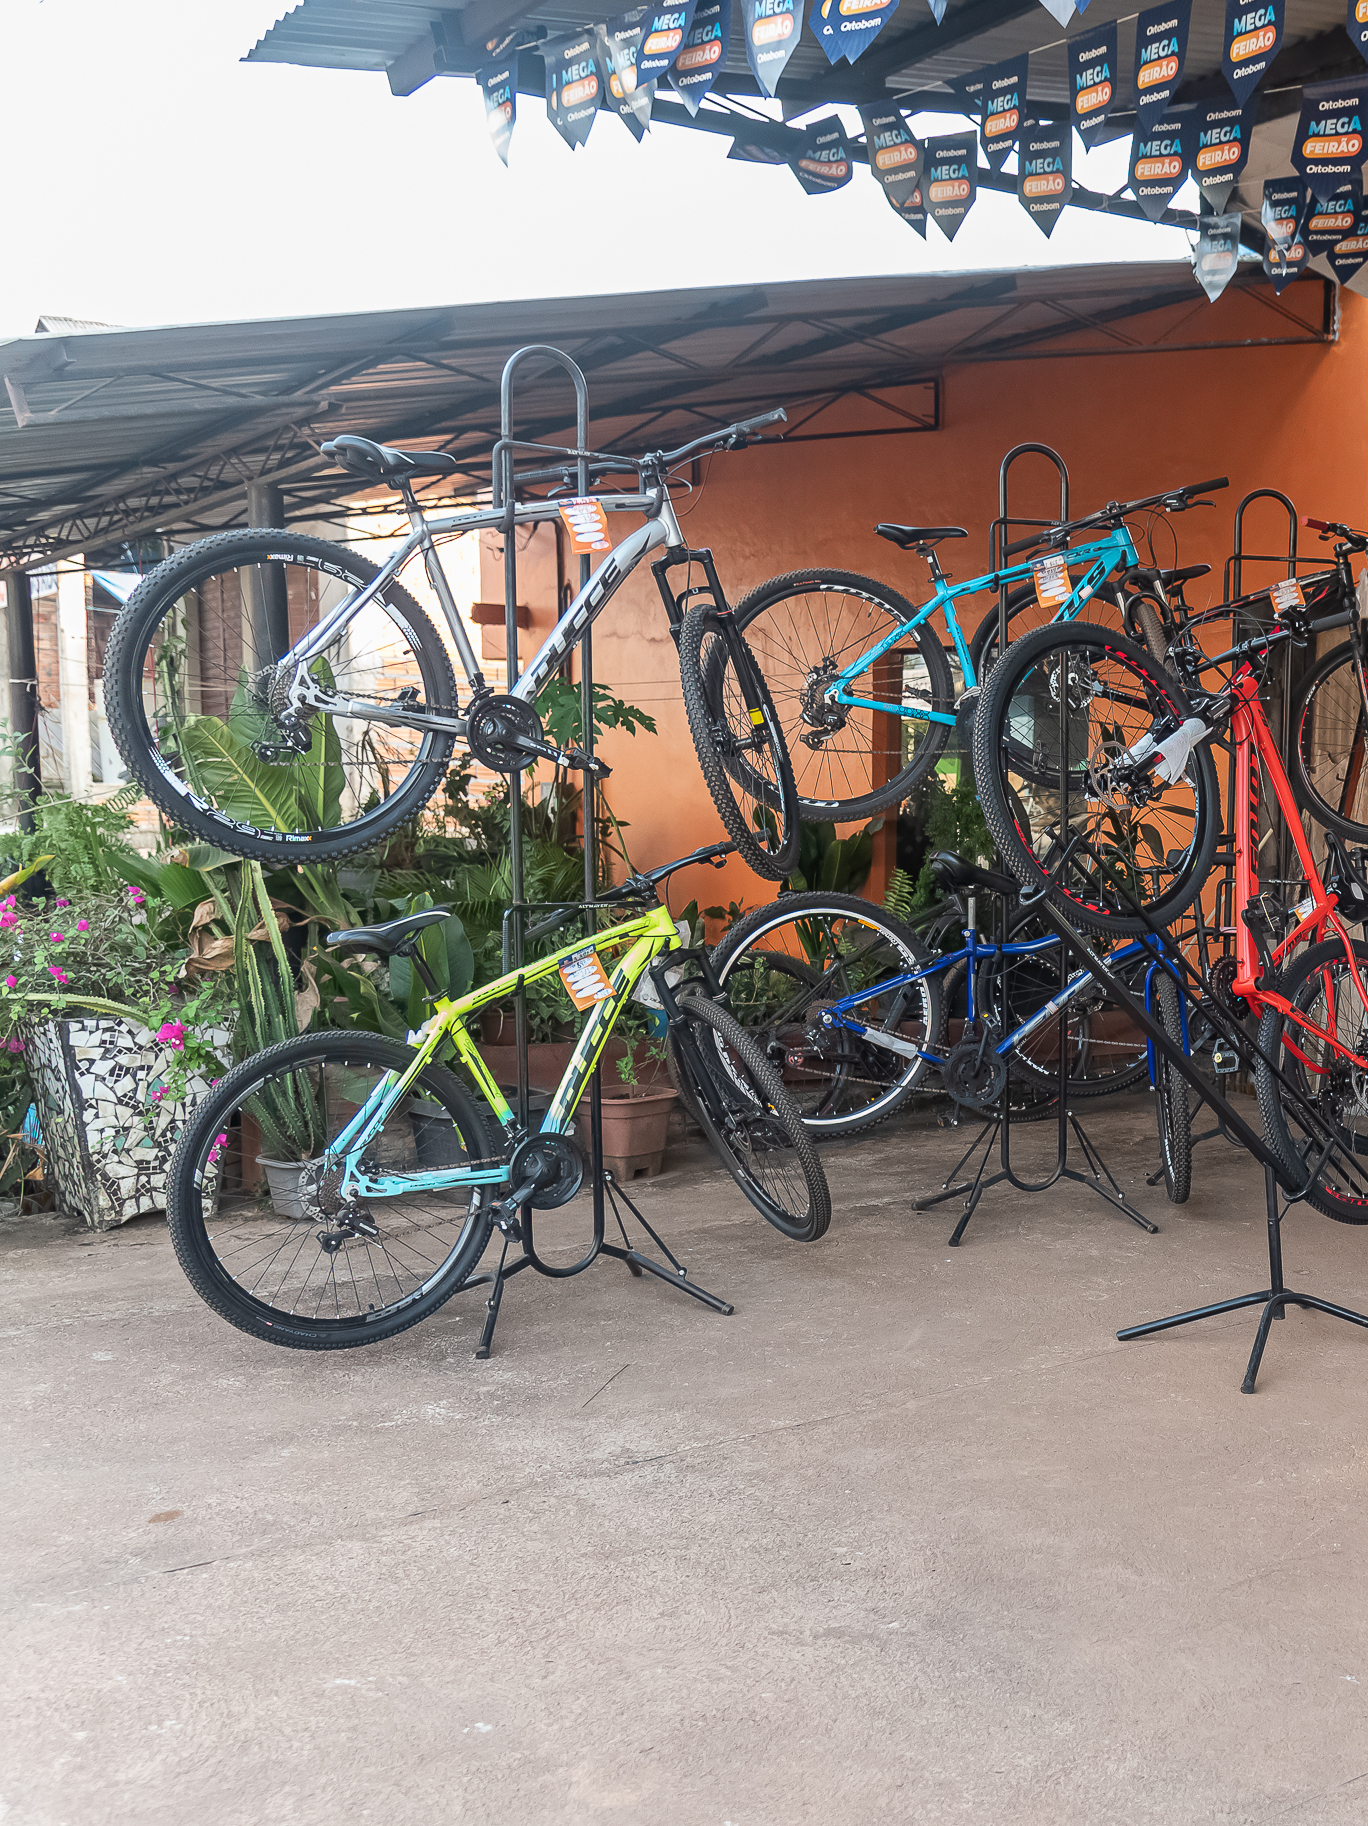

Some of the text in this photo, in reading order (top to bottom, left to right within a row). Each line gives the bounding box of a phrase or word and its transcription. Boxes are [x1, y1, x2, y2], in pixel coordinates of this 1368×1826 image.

[754, 0, 794, 18] MEGA
[651, 11, 686, 31] MEGA
[840, 17, 882, 32] Ortobom
[1146, 18, 1178, 36] Ortobom
[1233, 6, 1276, 35] MEGA
[754, 20, 791, 40] FEIRÃO
[564, 41, 590, 59] Ortobom
[645, 32, 682, 52] FEIRÃO
[1140, 37, 1179, 64] MEGA
[1233, 31, 1274, 56] FEIRÃO
[678, 46, 719, 66] FEIRÃO
[1078, 46, 1107, 63] Ortobom
[562, 58, 596, 85] MEGA
[678, 72, 712, 87] Ortobom
[1076, 63, 1110, 90] MEGA
[1139, 60, 1177, 83] FEIRÃO
[1233, 61, 1266, 80] Ortobom
[564, 82, 597, 102] FEIRÃO
[1077, 87, 1110, 112] FEIRÃO
[1139, 89, 1170, 106] Ortobom
[987, 92, 1019, 115] MEGA
[1318, 97, 1360, 111] Ortobom
[567, 105, 596, 122] Ortobom
[987, 116, 1018, 135] FEIRÃO
[1308, 115, 1362, 136] MEGA
[874, 129, 910, 149] MEGA
[1200, 125, 1242, 146] MEGA
[805, 146, 846, 162] MEGA
[1138, 139, 1182, 157] MEGA
[1200, 146, 1238, 165] FEIRÃO
[1306, 139, 1359, 155] FEIRÃO
[878, 146, 917, 167] FEIRÃO
[1025, 157, 1063, 174] MEGA
[800, 160, 846, 176] FEIRÃO
[930, 163, 969, 181] MEGA
[1138, 161, 1180, 176] FEIRÃO
[931, 185, 968, 199] FEIRÃO
[1026, 178, 1063, 194] FEIRÃO
[1315, 199, 1354, 214] MEGA
[285, 833, 313, 842] Rimaxx
